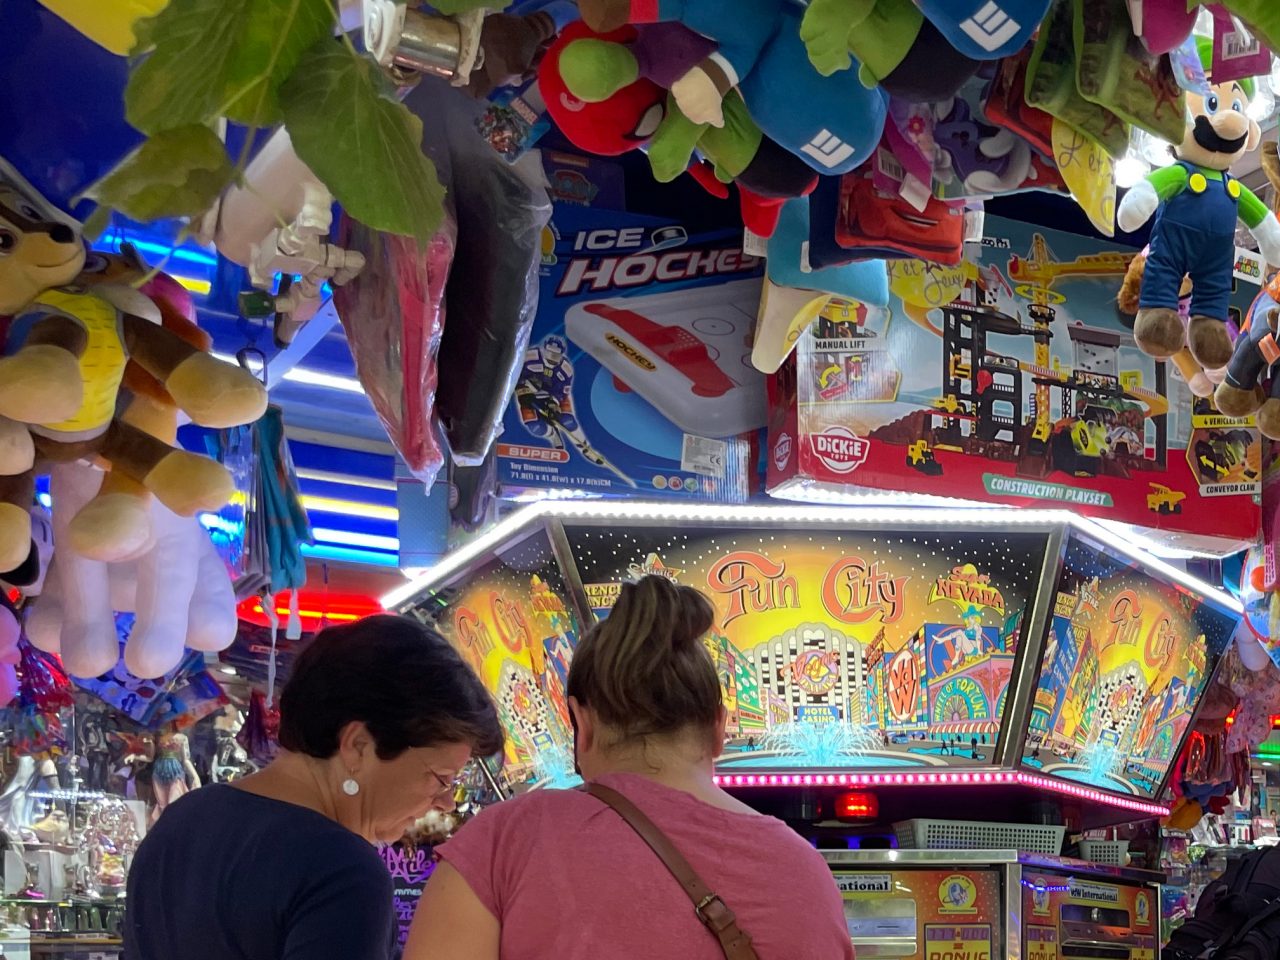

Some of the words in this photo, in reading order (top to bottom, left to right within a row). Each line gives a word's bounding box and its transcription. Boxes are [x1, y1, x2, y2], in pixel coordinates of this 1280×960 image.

[574, 227, 645, 251] ICE
[1233, 263, 1261, 278] MARIO
[815, 341, 848, 350] MANUAL
[849, 340, 866, 348] LIFT
[606, 334, 656, 371] HOCKEY
[1209, 416, 1236, 425] VEHICLES
[509, 447, 562, 460] SUPER
[830, 453, 849, 461] TOYS
[990, 477, 1063, 500] CONSTRUCTION
[1064, 486, 1107, 505] PLAYSET
[1206, 485, 1239, 494] CONVEYOR
[1240, 484, 1256, 493] CLAW
[706, 550, 801, 630] Fun
[821, 556, 912, 624] City
[936, 578, 1005, 609] NEVADA
[1100, 589, 1144, 654] Fun
[934, 692, 948, 722] WHEEL
[945, 684, 953, 693] OF
[956, 678, 988, 719] FORTUNE
[804, 707, 833, 715] HOTEL
[801, 715, 836, 723] CASINO
[1082, 889, 1118, 902] International
